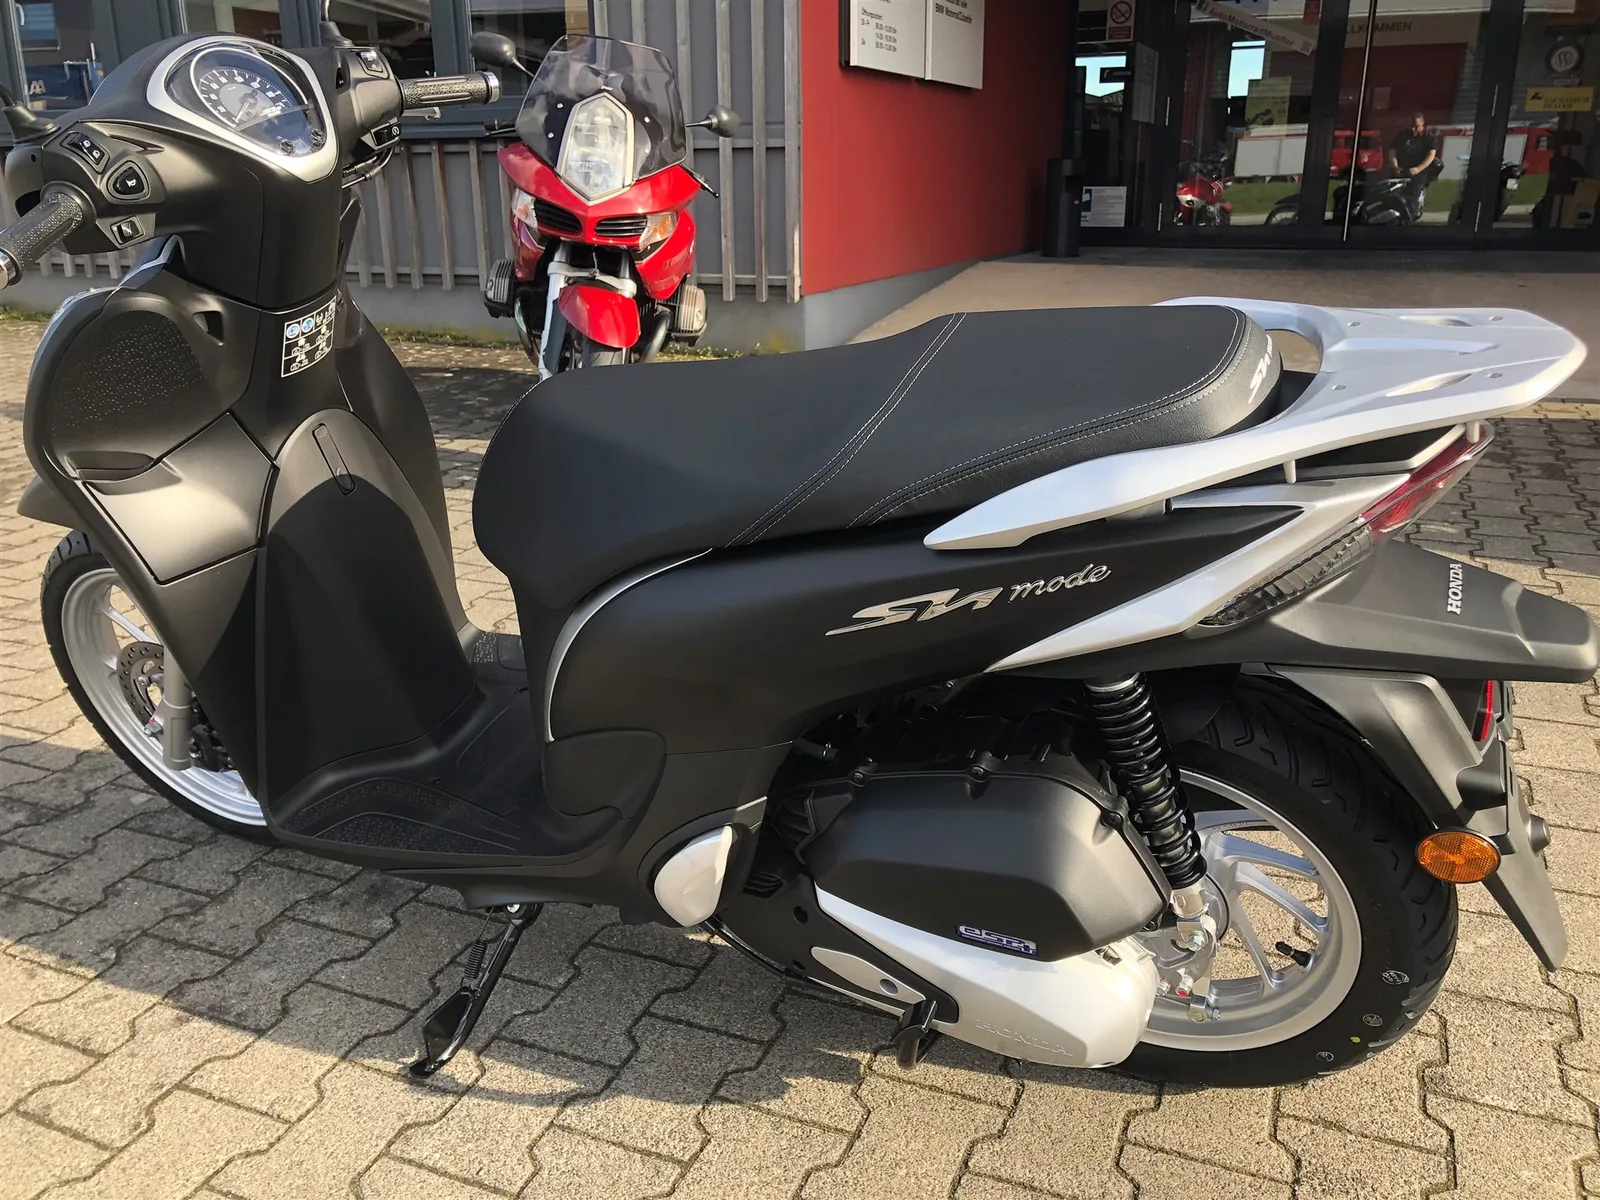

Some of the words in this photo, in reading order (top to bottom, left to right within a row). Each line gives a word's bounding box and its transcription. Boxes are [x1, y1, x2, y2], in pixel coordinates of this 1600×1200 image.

[1346, 21, 1412, 34] LKMMEN
[1008, 562, 1112, 604] mode
[1447, 562, 1462, 615] HONDA
[975, 1018, 1075, 1057] HONDA
